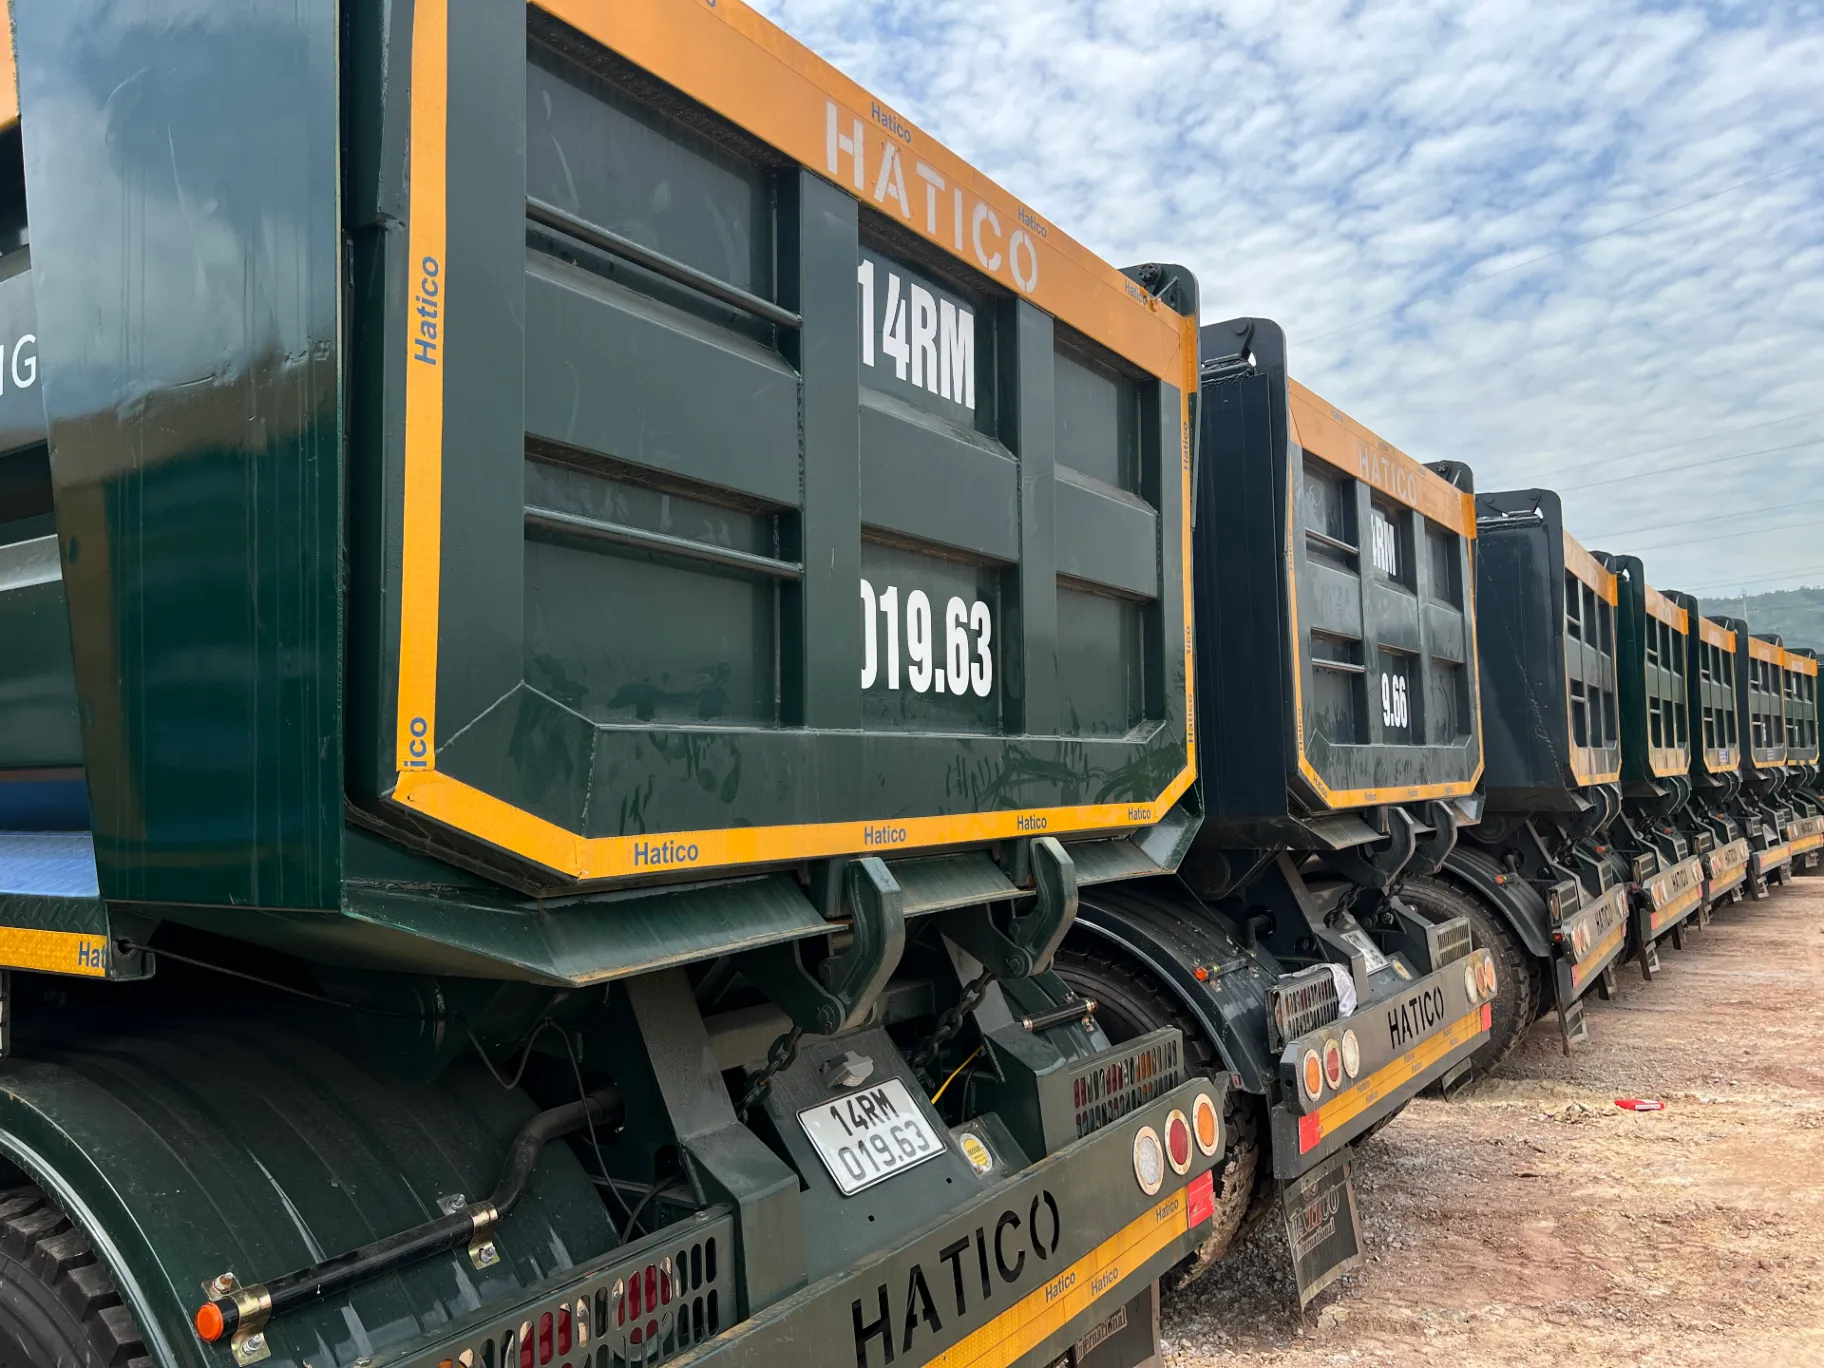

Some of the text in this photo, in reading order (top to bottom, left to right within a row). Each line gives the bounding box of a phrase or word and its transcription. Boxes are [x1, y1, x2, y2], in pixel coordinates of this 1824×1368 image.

[871, 102, 912, 144] Hatico
[826, 101, 1038, 293] HATICO
[1017, 206, 1047, 238] Hatico
[414, 256, 439, 365] Hatico
[858, 259, 975, 409] 14RM
[0, 334, 36, 395] G
[1358, 442, 1418, 505] HATICO
[404, 716, 427, 771] ico
[864, 825, 907, 846] Hatico
[1017, 815, 1047, 831] Hatico
[1128, 806, 1152, 821] Hatico
[634, 840, 699, 867] Hatico
[1388, 986, 1444, 1049] HATICO
[830, 1088, 901, 1137] 14RM
[838, 1120, 931, 1182] 019.63
[1156, 1199, 1179, 1222] Hatico
[852, 1190, 1060, 1368] HATICO
[1045, 1272, 1076, 1302] Hatico
[1091, 1267, 1119, 1296] Hatico
